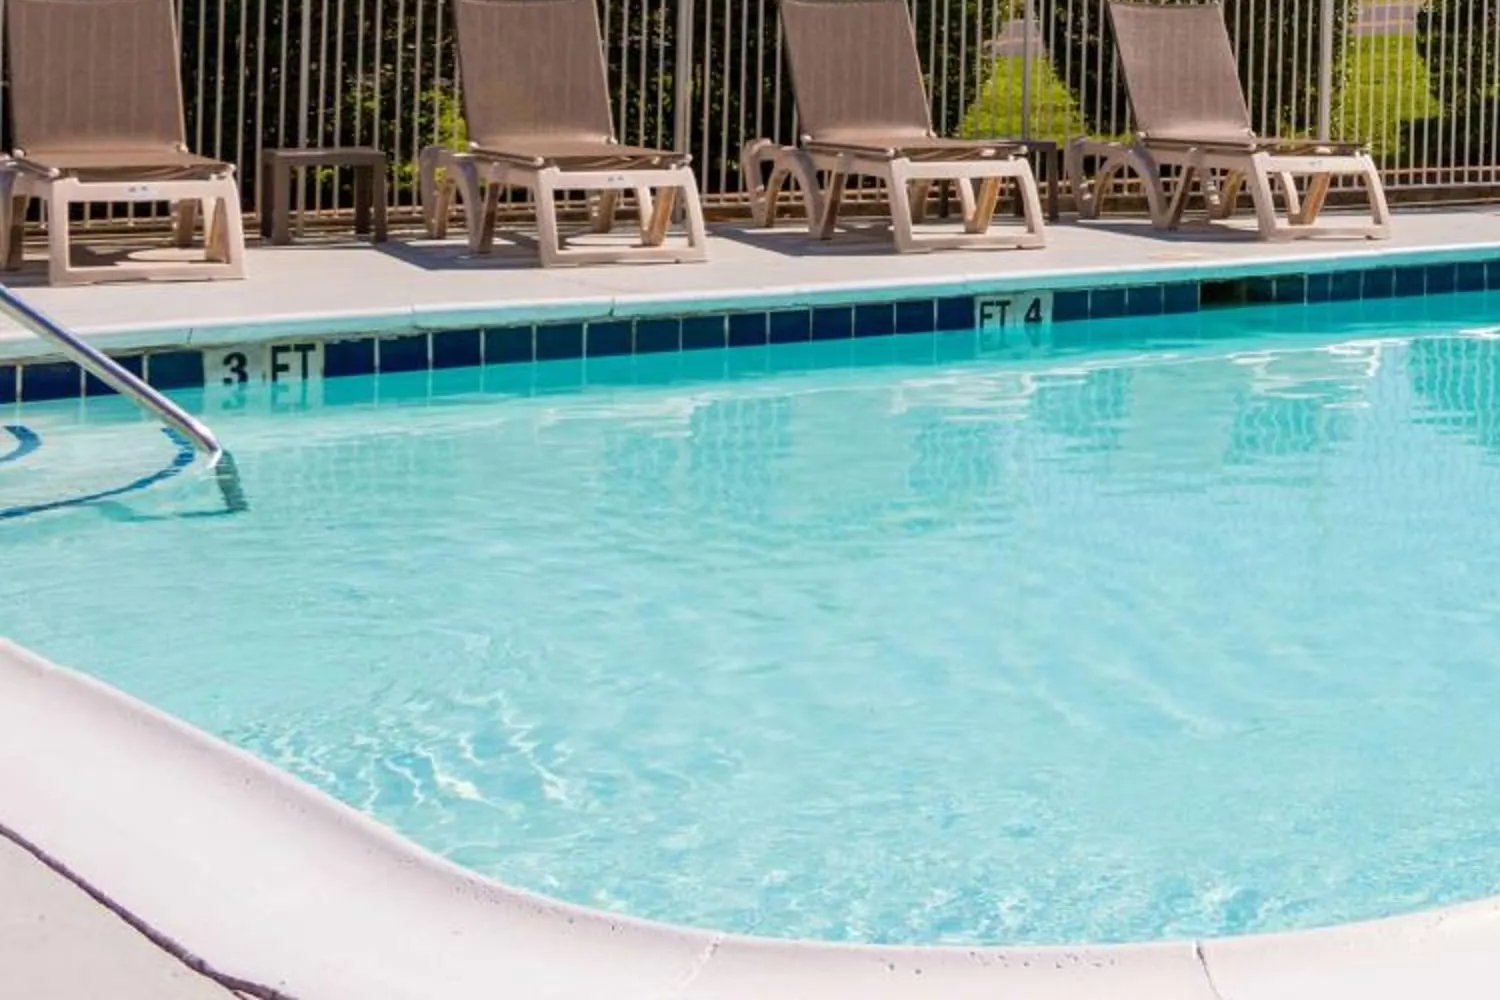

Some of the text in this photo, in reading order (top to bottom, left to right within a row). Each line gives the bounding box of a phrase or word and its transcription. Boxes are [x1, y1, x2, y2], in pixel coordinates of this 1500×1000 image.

[980, 296, 1043, 329] FT 4
[222, 342, 317, 385] 3 FT
